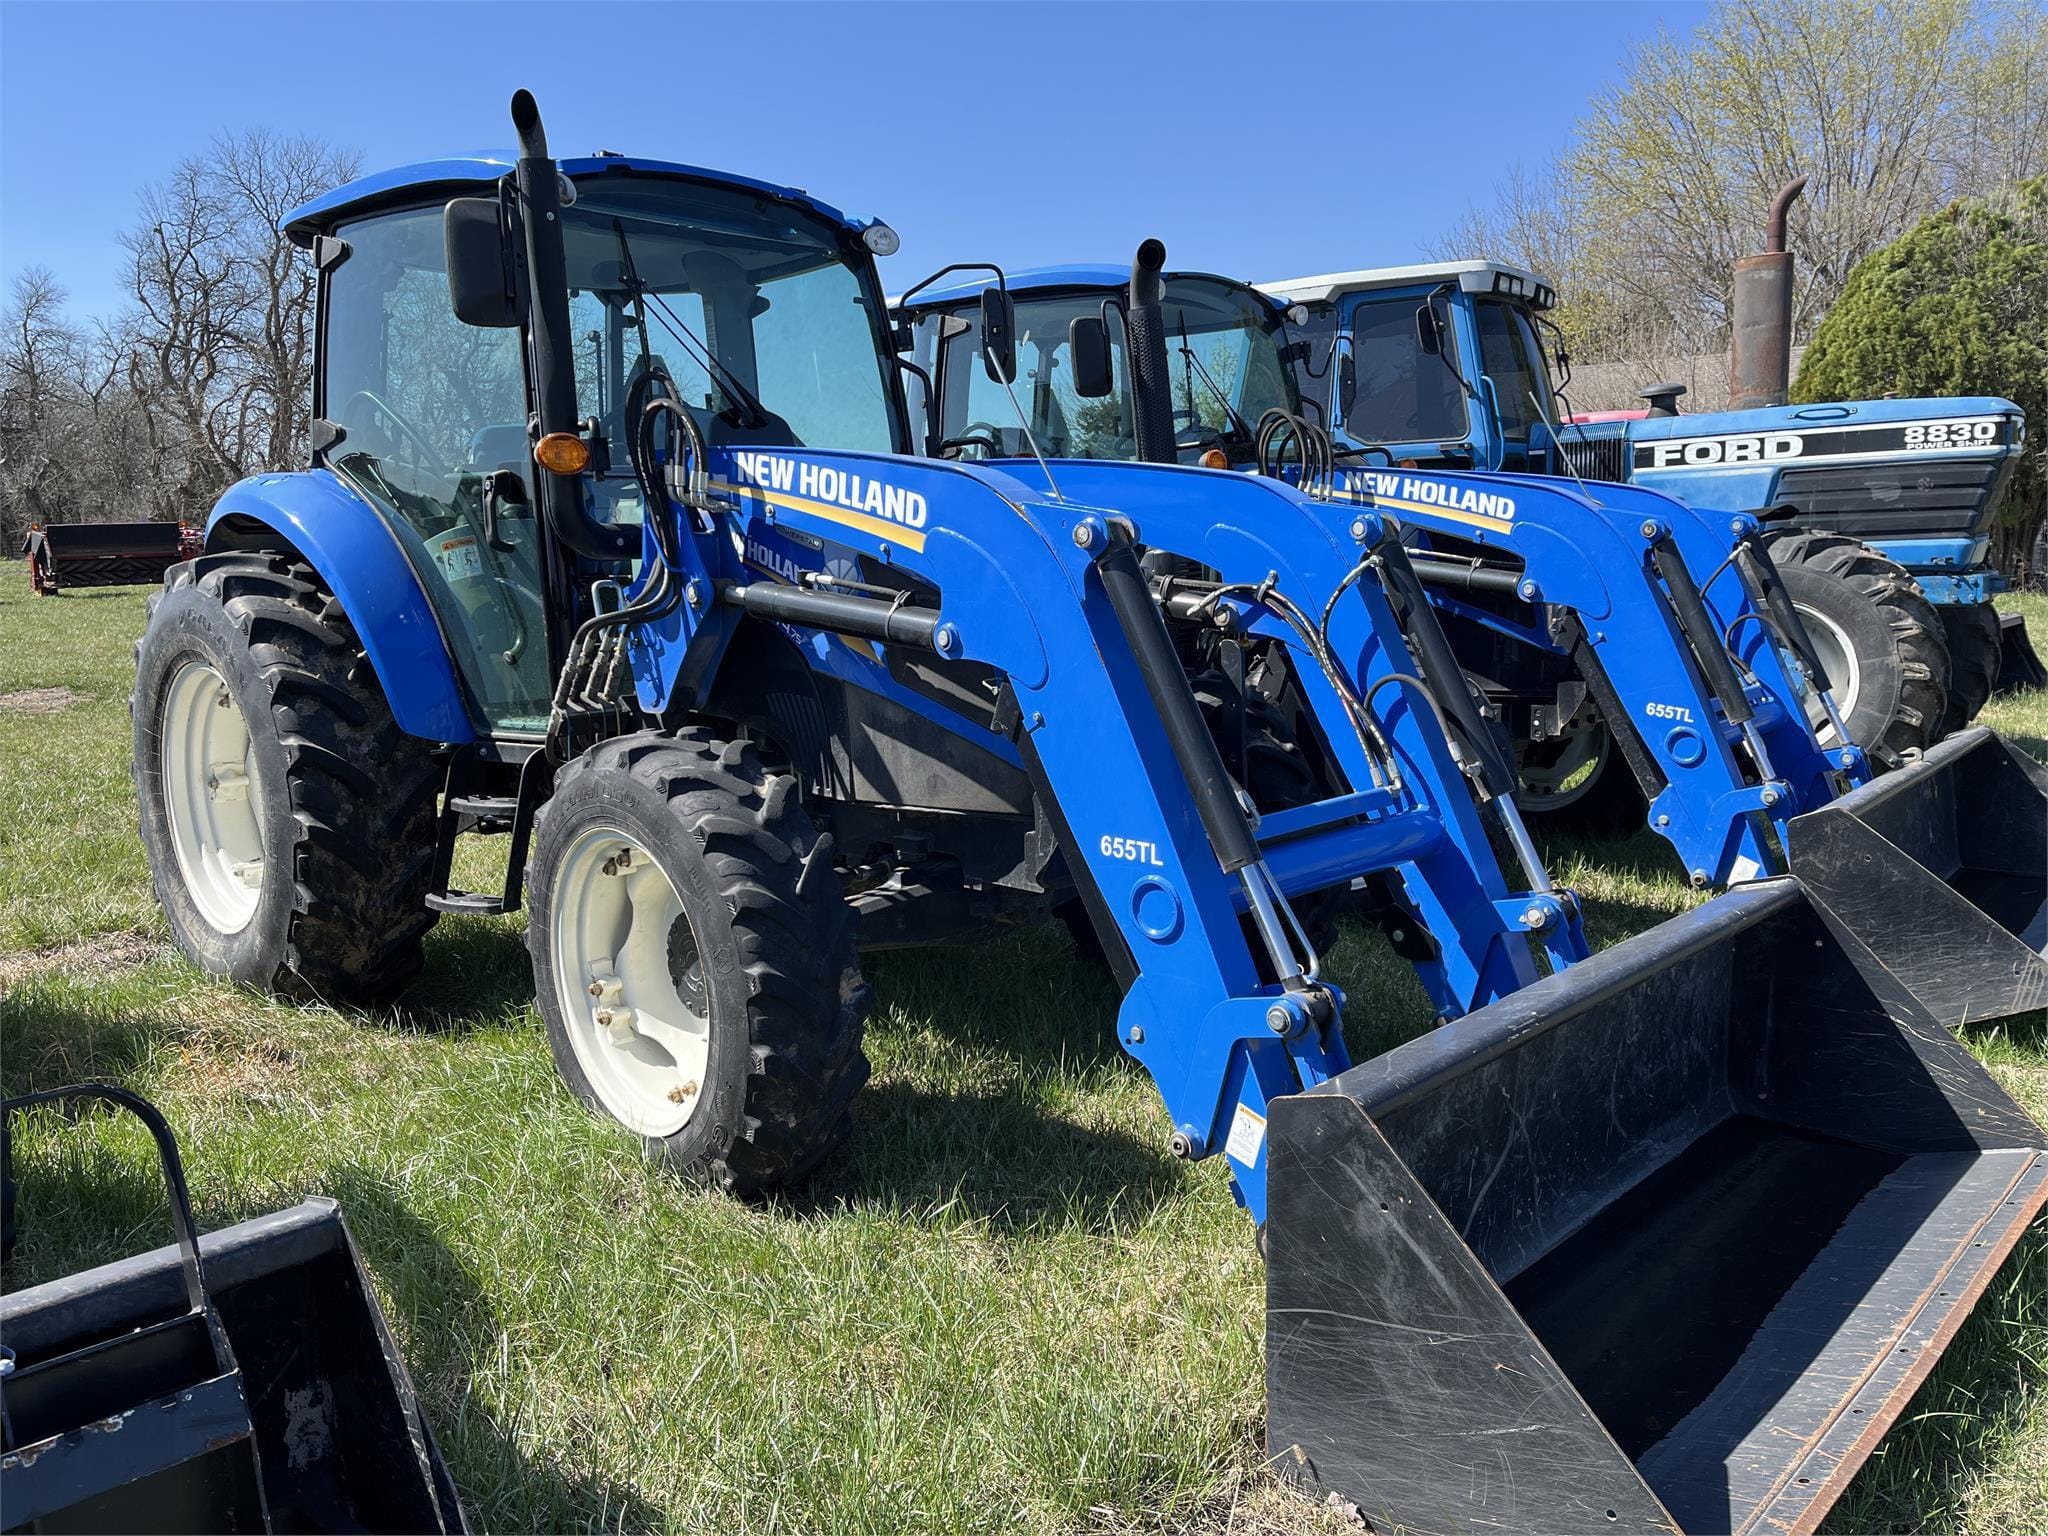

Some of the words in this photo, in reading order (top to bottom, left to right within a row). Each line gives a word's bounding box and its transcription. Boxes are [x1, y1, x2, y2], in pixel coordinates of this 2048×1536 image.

[1903, 421, 1997, 443] 8830
[1906, 441, 1953, 451] POWER
[1653, 434, 1804, 468] FORD
[737, 451, 795, 492] NEW
[799, 461, 927, 529] HOLLAND
[1344, 470, 1400, 497] NEW
[1402, 478, 1516, 520] HOLLAND
[747, 539, 800, 584] HOLLA
[1646, 702, 1695, 723] 655TL
[1100, 834, 1164, 866] 655TL
